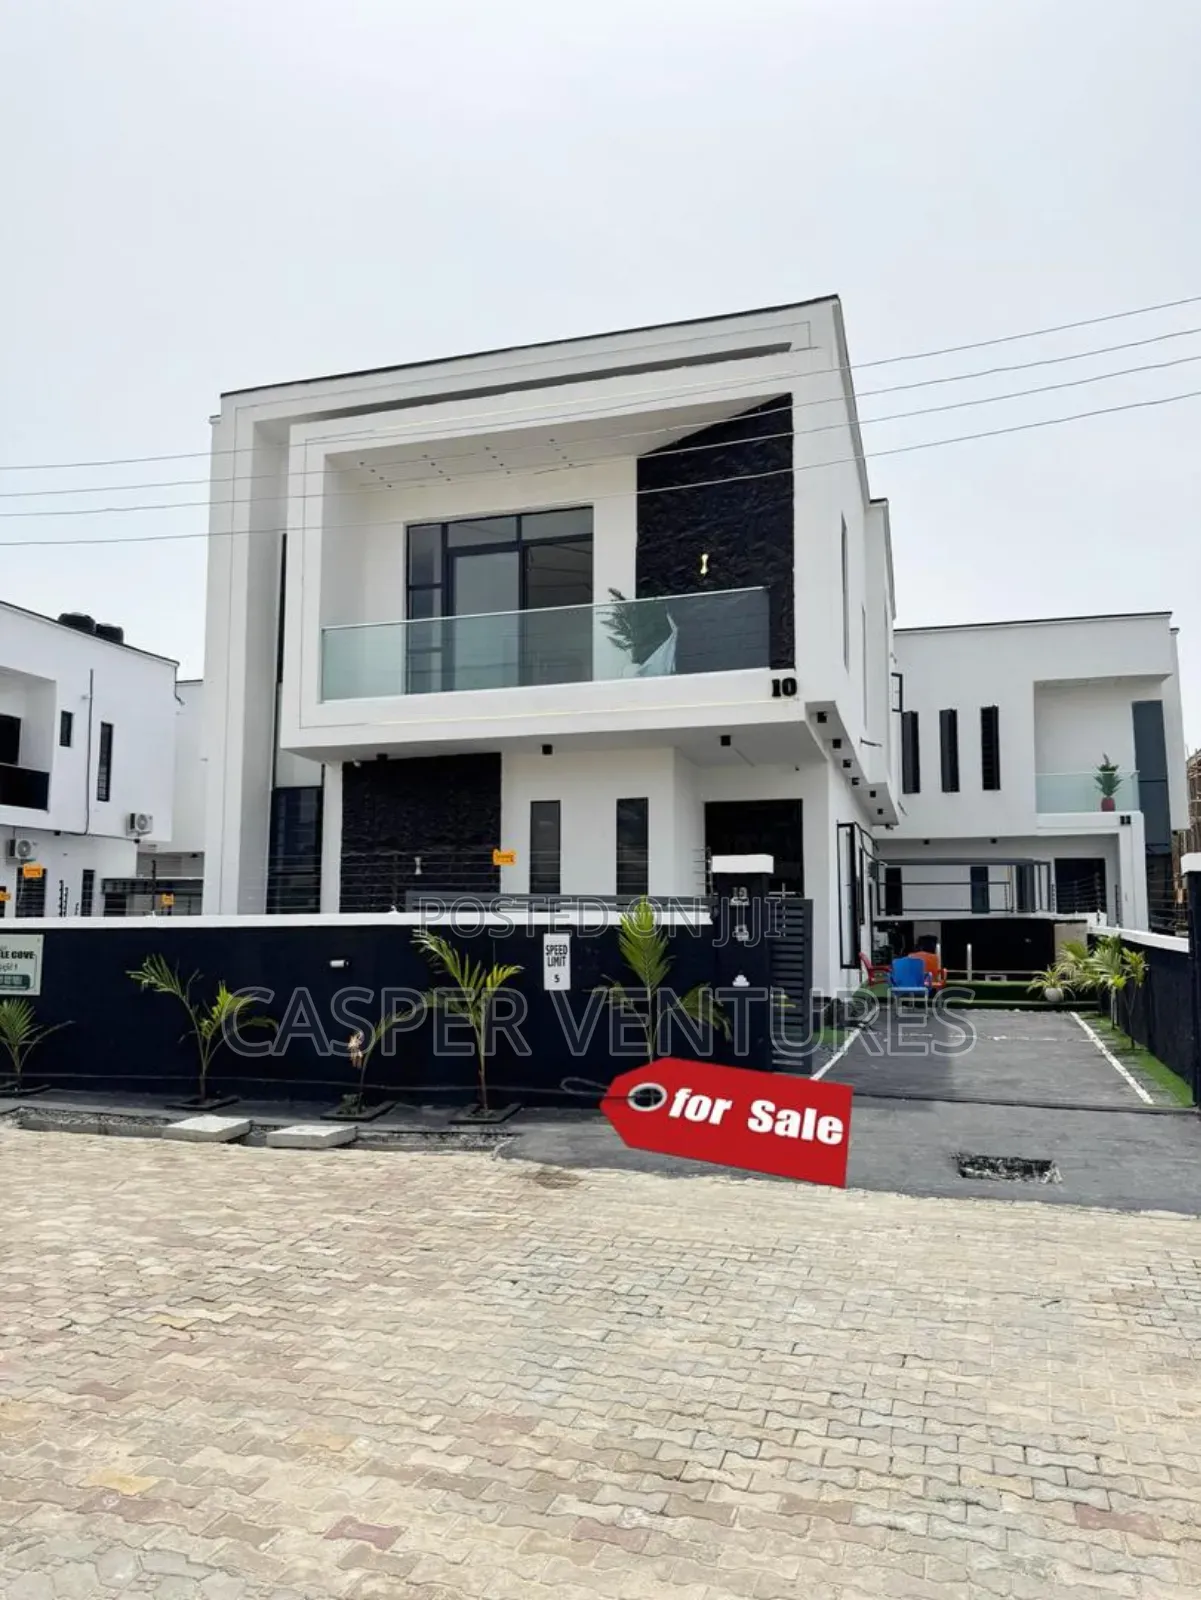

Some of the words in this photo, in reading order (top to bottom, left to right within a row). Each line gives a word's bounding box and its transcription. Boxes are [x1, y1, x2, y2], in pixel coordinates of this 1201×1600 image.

[772, 677, 797, 697] 10
[11, 950, 35, 959] COVE
[545, 945, 568, 956] SPEED
[547, 956, 566, 967] LIMIT
[554, 974, 560, 983] 5
